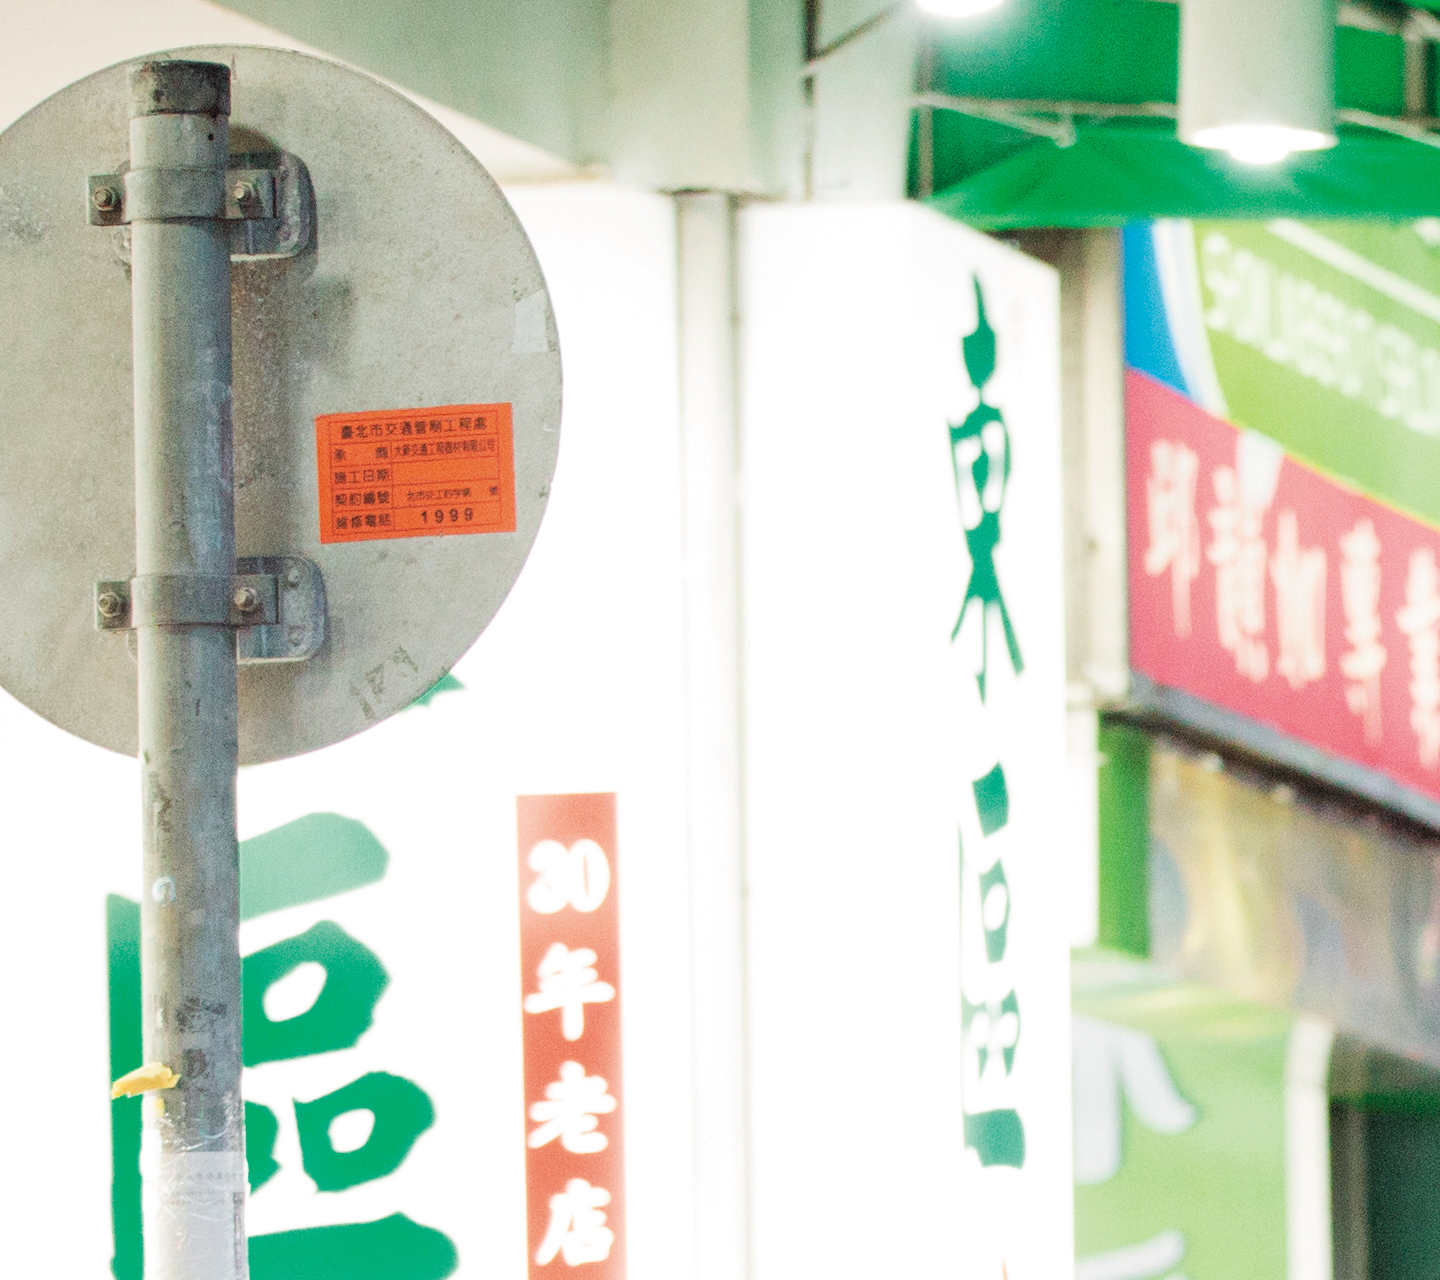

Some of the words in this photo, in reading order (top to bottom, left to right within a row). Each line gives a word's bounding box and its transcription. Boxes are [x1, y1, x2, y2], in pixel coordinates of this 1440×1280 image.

[421, 507, 473, 524] 1999
[523, 837, 618, 1268] 30年老店
